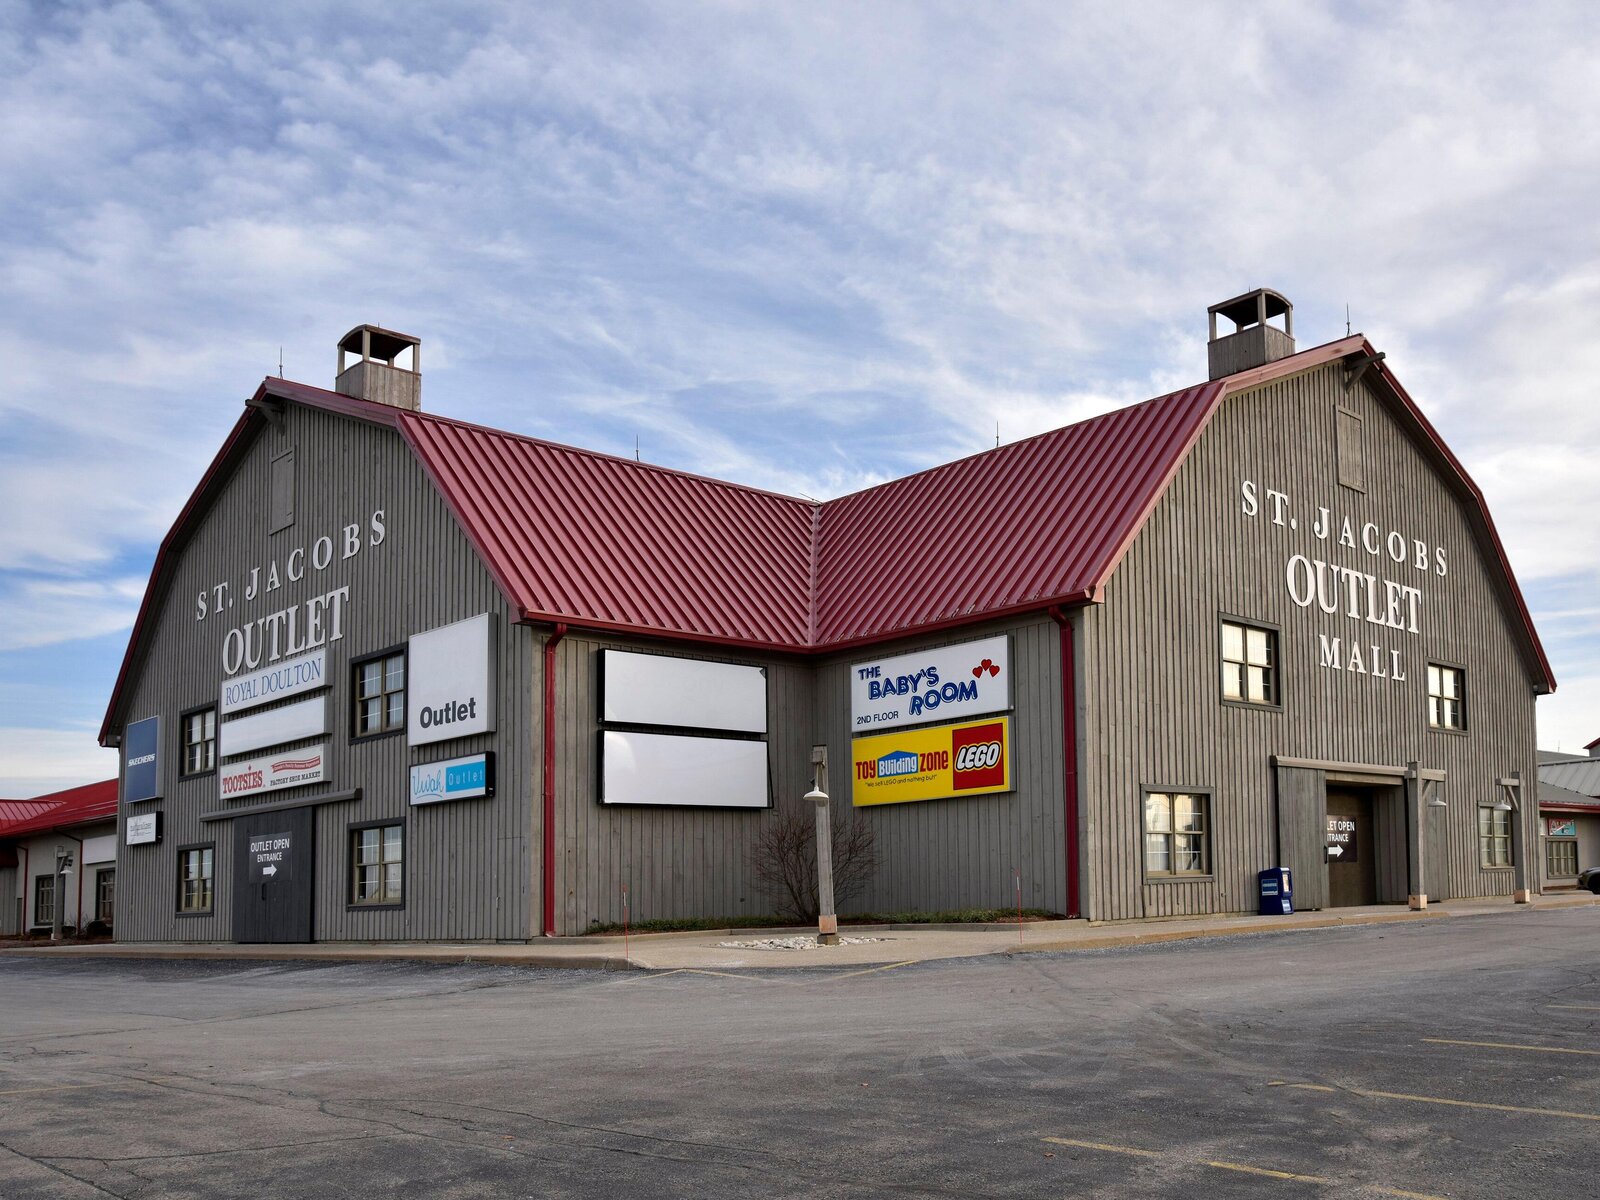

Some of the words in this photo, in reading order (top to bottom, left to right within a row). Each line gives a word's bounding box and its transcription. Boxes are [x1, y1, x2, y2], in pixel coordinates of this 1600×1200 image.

[1242, 480, 1297, 530] ST.
[1314, 507, 1447, 577] JACOBS
[197, 582, 233, 621] ST.
[246, 510, 385, 600] JACOBS
[1286, 555, 1421, 634] OUTLET
[223, 586, 350, 675] OUTLET
[1319, 634, 1405, 681] MALL
[225, 679, 258, 706] ROYAL
[261, 658, 322, 696] DOULTON
[858, 666, 881, 680] THE
[868, 666, 940, 700] BABY'S
[909, 679, 978, 716] ROOM
[420, 697, 476, 729] Outlet
[857, 715, 871, 725] 2ND
[873, 711, 899, 722] FLOOR
[128, 753, 155, 767] SKECHERS
[956, 742, 1001, 770] LEGO
[301, 771, 320, 780] MARKET
[448, 769, 483, 786] Outlet
[1337, 821, 1355, 831] OPEN
[251, 840, 273, 852] OUTLET
[273, 838, 290, 850] OPEN
[257, 852, 282, 862] ENTRANCE
